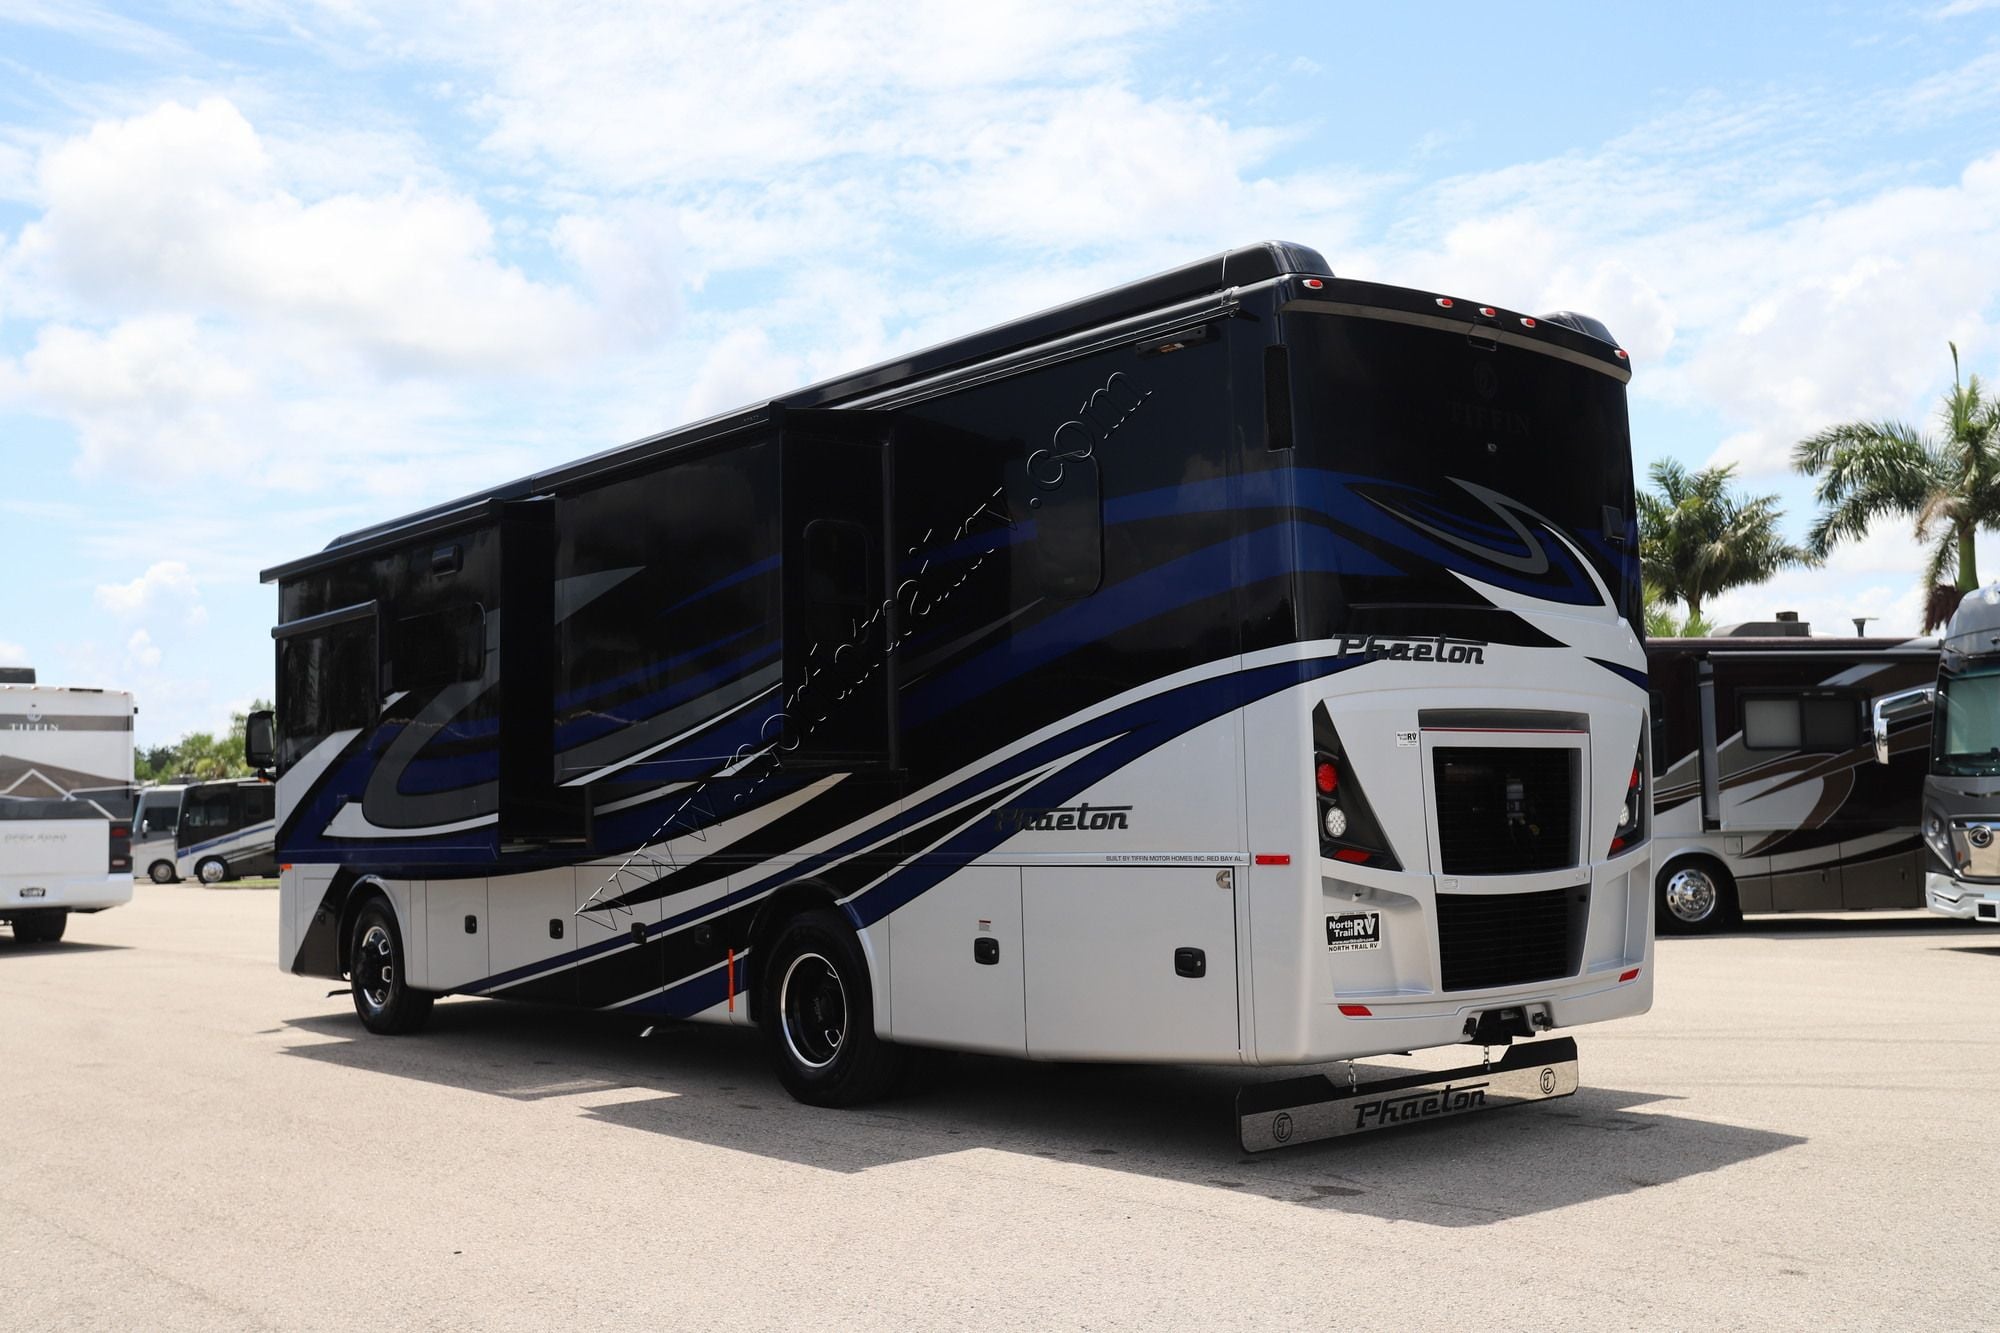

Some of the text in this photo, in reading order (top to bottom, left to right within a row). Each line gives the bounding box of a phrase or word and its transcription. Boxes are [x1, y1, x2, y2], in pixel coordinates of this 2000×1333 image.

[1448, 400, 1530, 436] TIFFIN
[1331, 633, 1488, 665] Phaeton
[990, 803, 1133, 831] Phaeton
[1329, 920, 1353, 929] North
[1334, 918, 1376, 937] Trail RV
[1354, 1082, 1489, 1128] Phaeton
